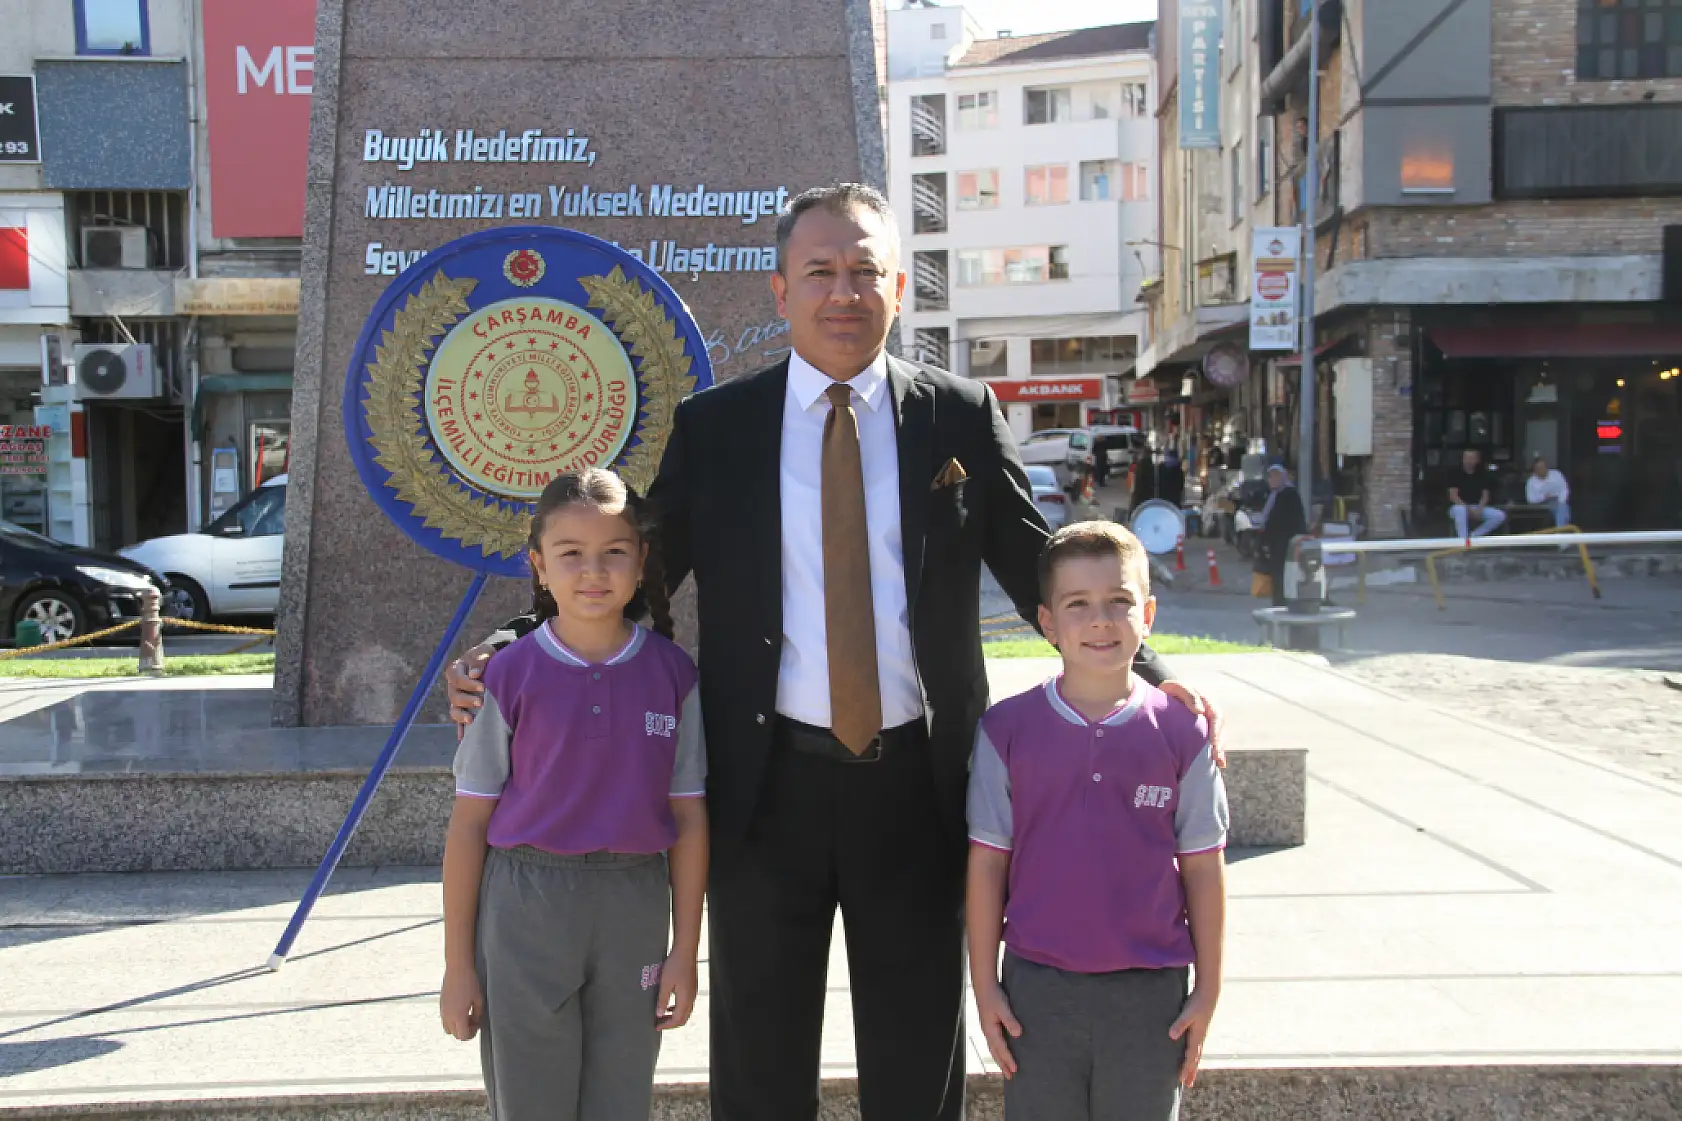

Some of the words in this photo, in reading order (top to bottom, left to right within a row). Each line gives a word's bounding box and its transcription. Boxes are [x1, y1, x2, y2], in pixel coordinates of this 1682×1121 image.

[454, 128, 596, 167] Hedefimiz,
[509, 192, 542, 218] en
[548, 184, 643, 217] Yuksek
[648, 240, 777, 282] Ulaştırma
[472, 306, 592, 341] ÇARŞAMBA
[433, 377, 456, 416] İLÇE
[1018, 383, 1083, 396] AKBANK
[441, 418, 482, 467] MİLLİ
[481, 462, 550, 488] EĞİTİM
